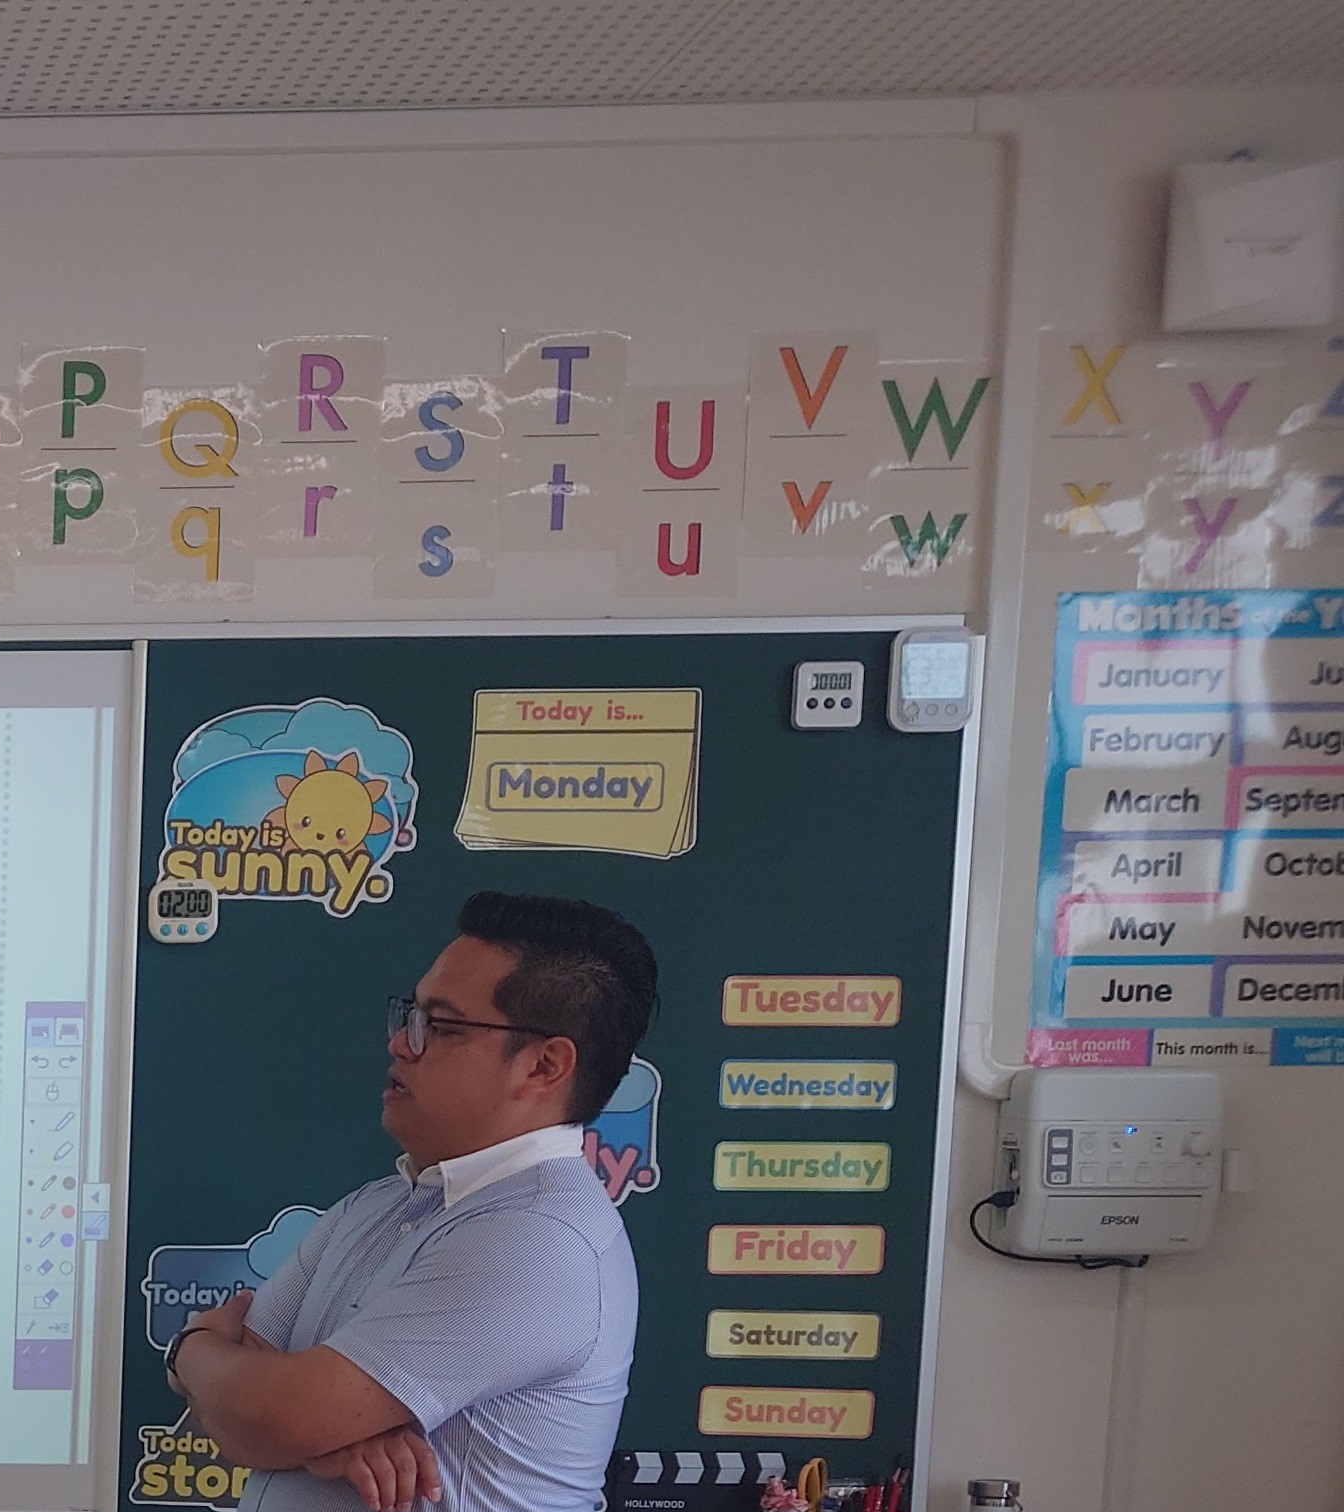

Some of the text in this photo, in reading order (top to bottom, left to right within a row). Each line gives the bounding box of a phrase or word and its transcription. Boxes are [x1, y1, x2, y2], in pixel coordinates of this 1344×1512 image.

[62, 361, 106, 438] P
[298, 354, 347, 432] R
[541, 346, 589, 424] T
[780, 346, 848, 429] V
[1062, 346, 1126, 424] X
[415, 392, 464, 471] S
[882, 378, 990, 462] W
[1189, 382, 1254, 458] Y
[159, 398, 238, 477] Q
[654, 401, 715, 480] U
[304, 486, 337, 537] r
[171, 506, 220, 581] q
[1078, 598, 1243, 632] Months
[1098, 663, 1224, 693] January
[516, 701, 644, 725] Today is...
[1090, 728, 1227, 757] February
[497, 767, 653, 807] Monday
[1103, 788, 1200, 815] March
[171, 821, 285, 851] Today is
[165, 848, 390, 914] sunny.
[1111, 853, 1182, 884] April
[1109, 917, 1176, 946] May
[731, 982, 895, 1021] Tuesday
[1101, 978, 1173, 1003] June
[1047, 1037, 1131, 1050] Last month
[1156, 1041, 1239, 1056] This month
[727, 1073, 890, 1101] Wednesday
[722, 1151, 883, 1185] Thursday
[1100, 1216, 1140, 1225] EPSON
[734, 1231, 857, 1269] Friday
[148, 1283, 228, 1307] Today
[728, 1323, 859, 1352] Saturday
[724, 1398, 847, 1431] Sunday
[625, 1500, 685, 1509] HOLLYWOOD
